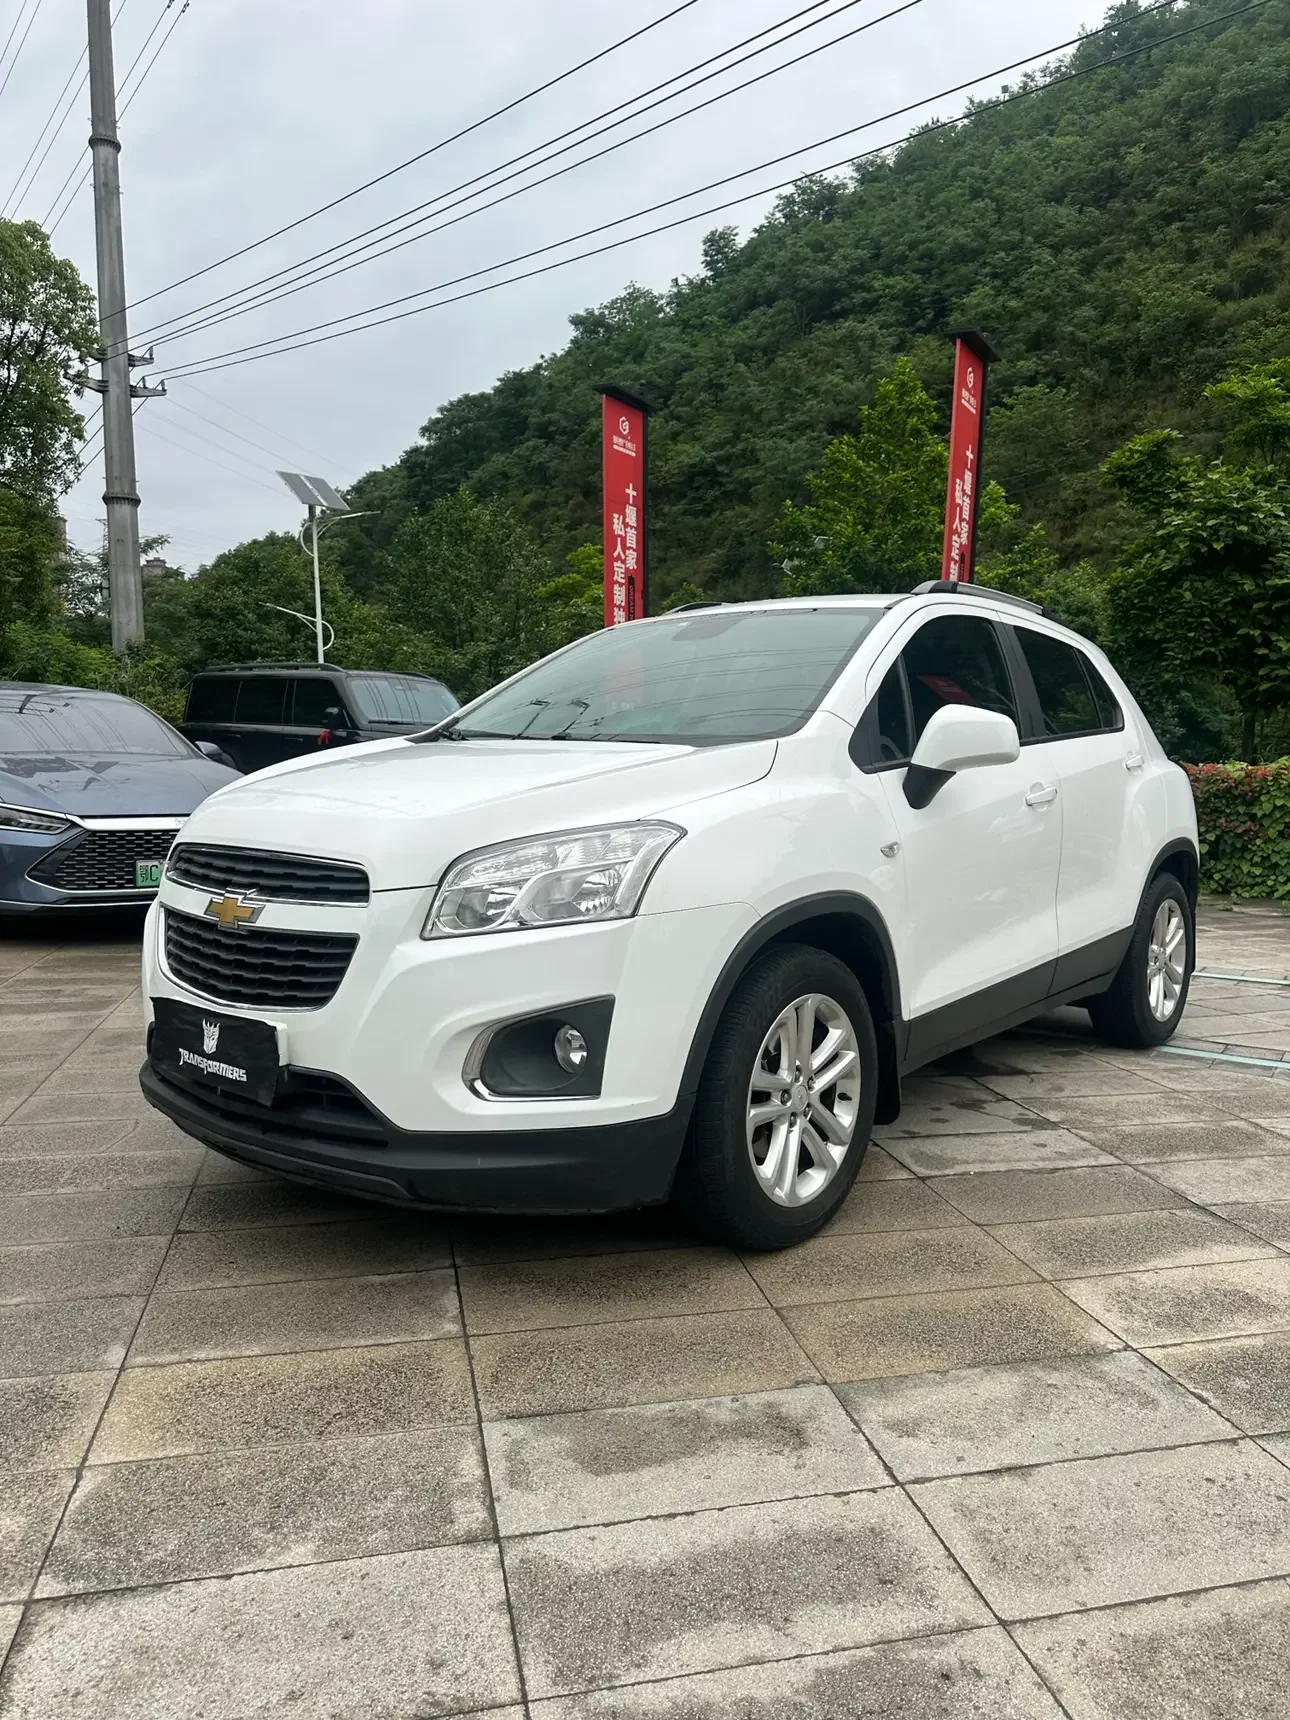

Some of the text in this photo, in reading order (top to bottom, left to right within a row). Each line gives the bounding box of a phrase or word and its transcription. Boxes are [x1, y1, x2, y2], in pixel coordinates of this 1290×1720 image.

[625, 483, 637, 570] 十堰首家
[960, 444, 974, 545] 十堰首家
[179, 1047, 248, 1082] TRANSFORMERS
